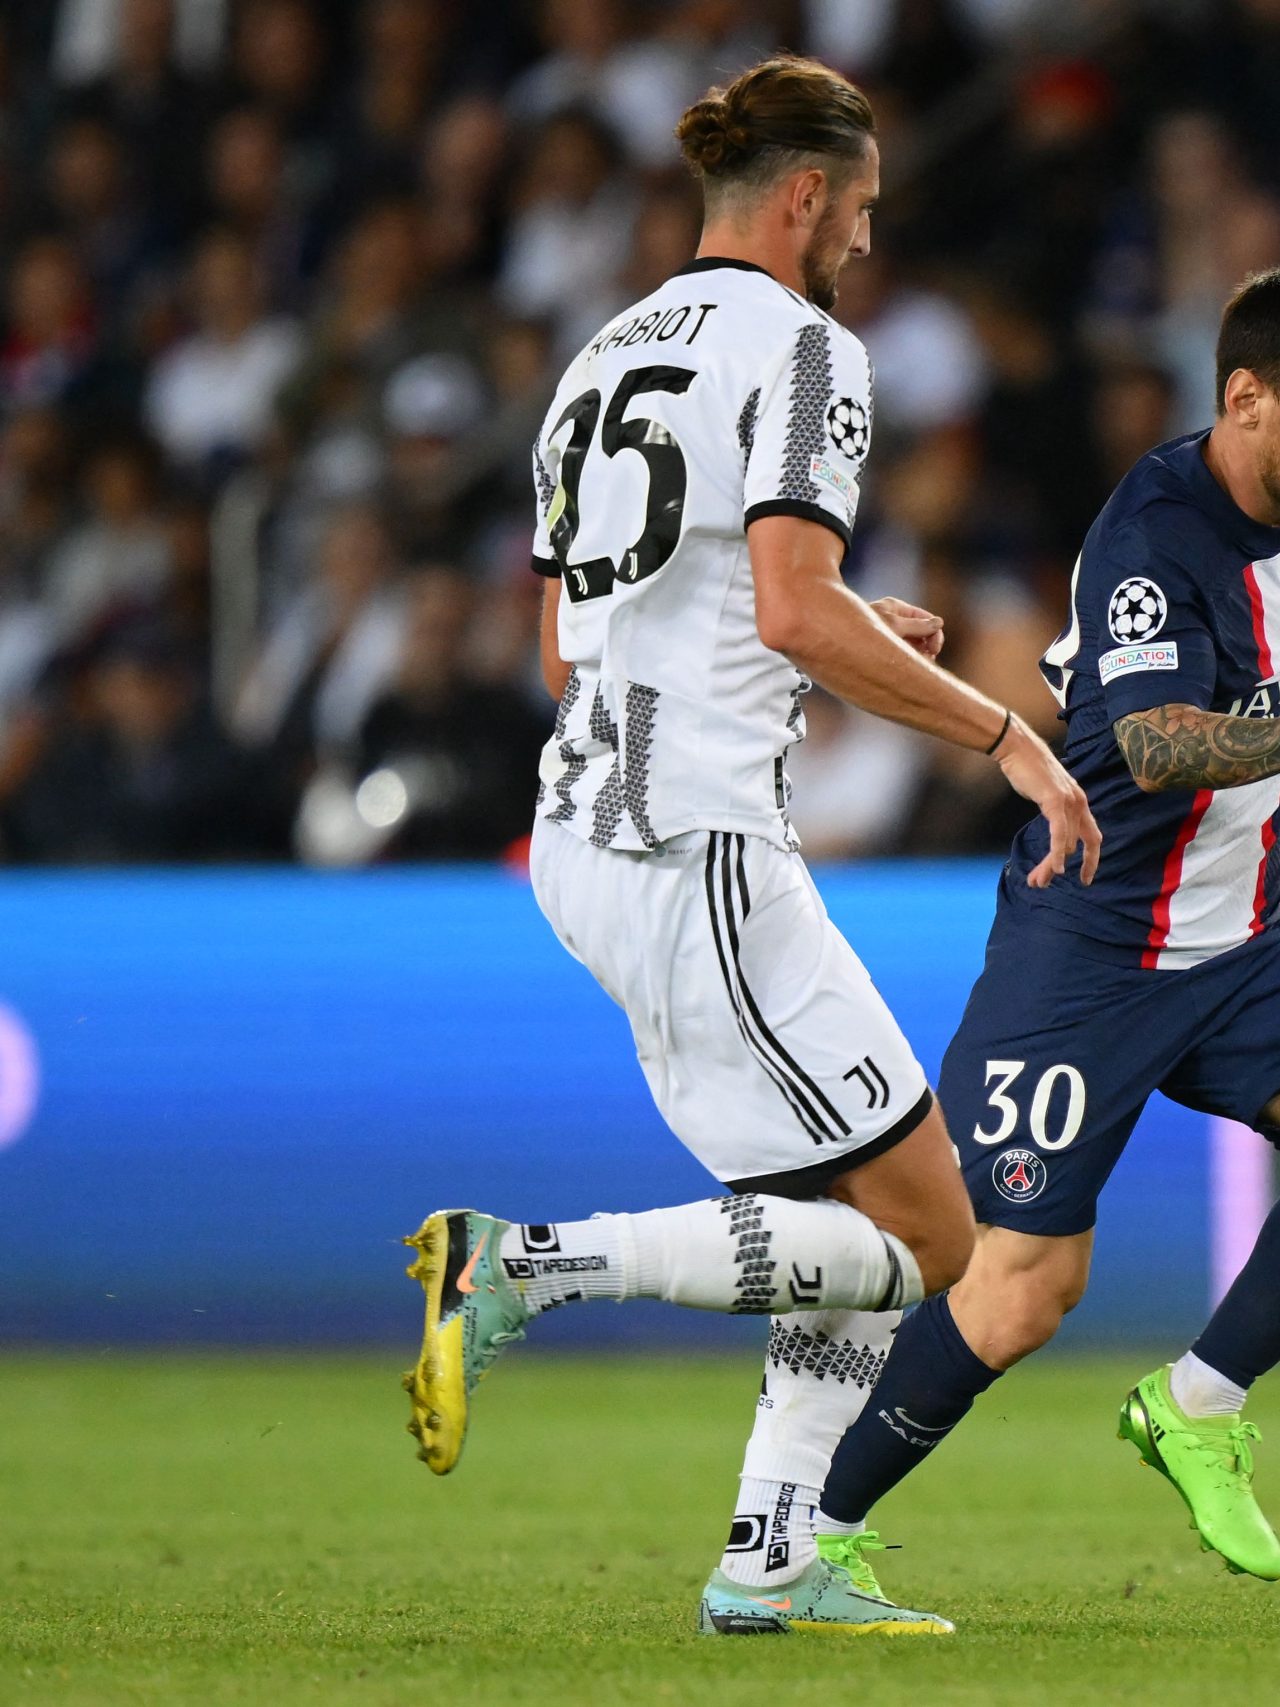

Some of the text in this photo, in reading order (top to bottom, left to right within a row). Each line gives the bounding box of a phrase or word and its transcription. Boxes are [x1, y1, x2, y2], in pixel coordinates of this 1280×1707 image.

[548, 364, 698, 604] 25
[1100, 650, 1175, 673] FOUNDATION
[973, 1060, 1086, 1150] 30
[1005, 1152, 1040, 1168] PARIS
[533, 1254, 607, 1275] TAPEDESIGN
[770, 1482, 796, 1543] TAPEDESIG
